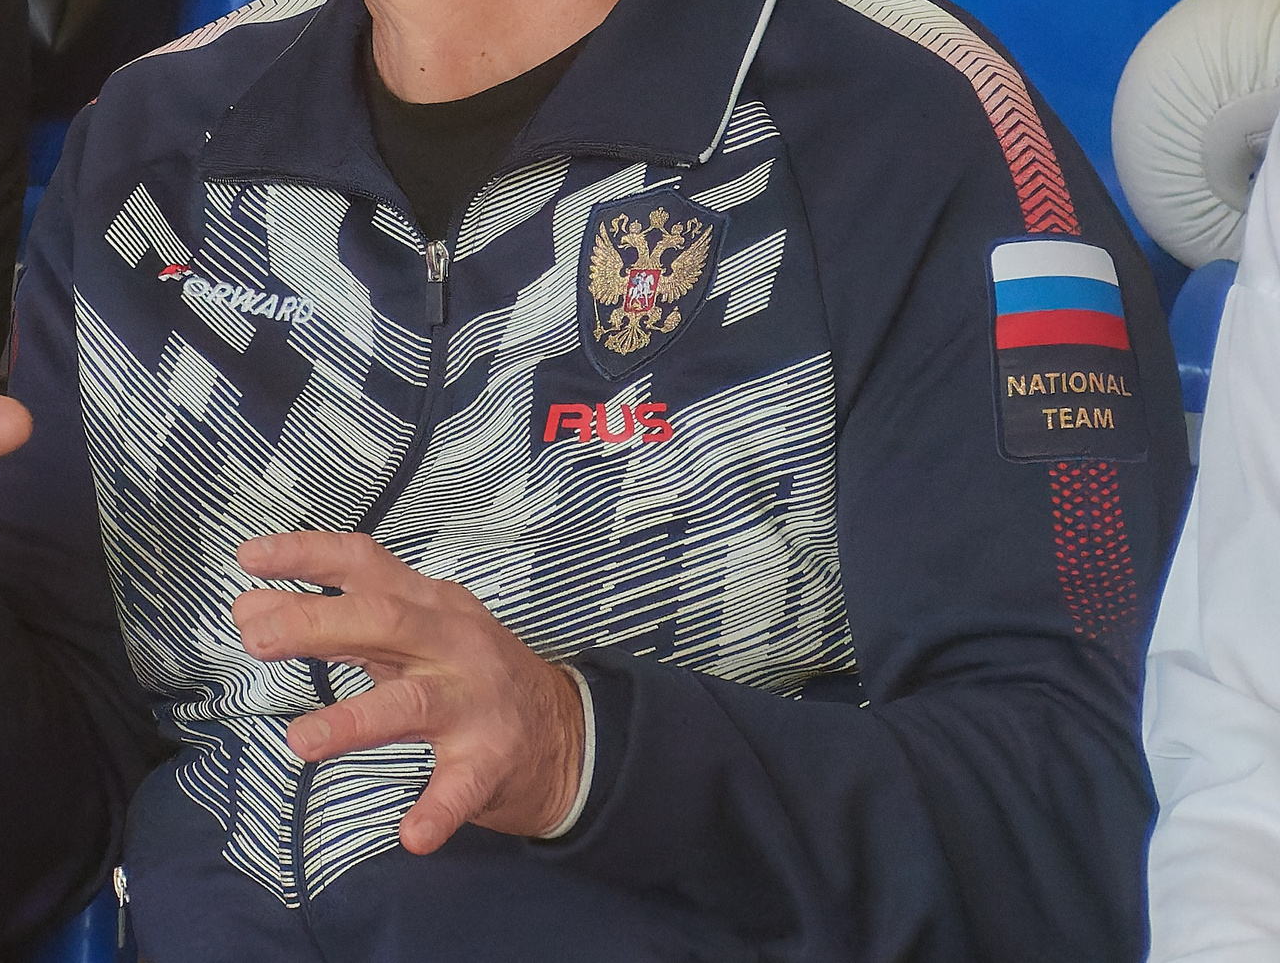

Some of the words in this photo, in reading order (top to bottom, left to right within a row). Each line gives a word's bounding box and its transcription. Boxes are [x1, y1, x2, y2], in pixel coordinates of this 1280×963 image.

[1006, 371, 1132, 398] NATIONAL
[543, 402, 675, 444] RUS
[1042, 407, 1115, 430] TEAM
